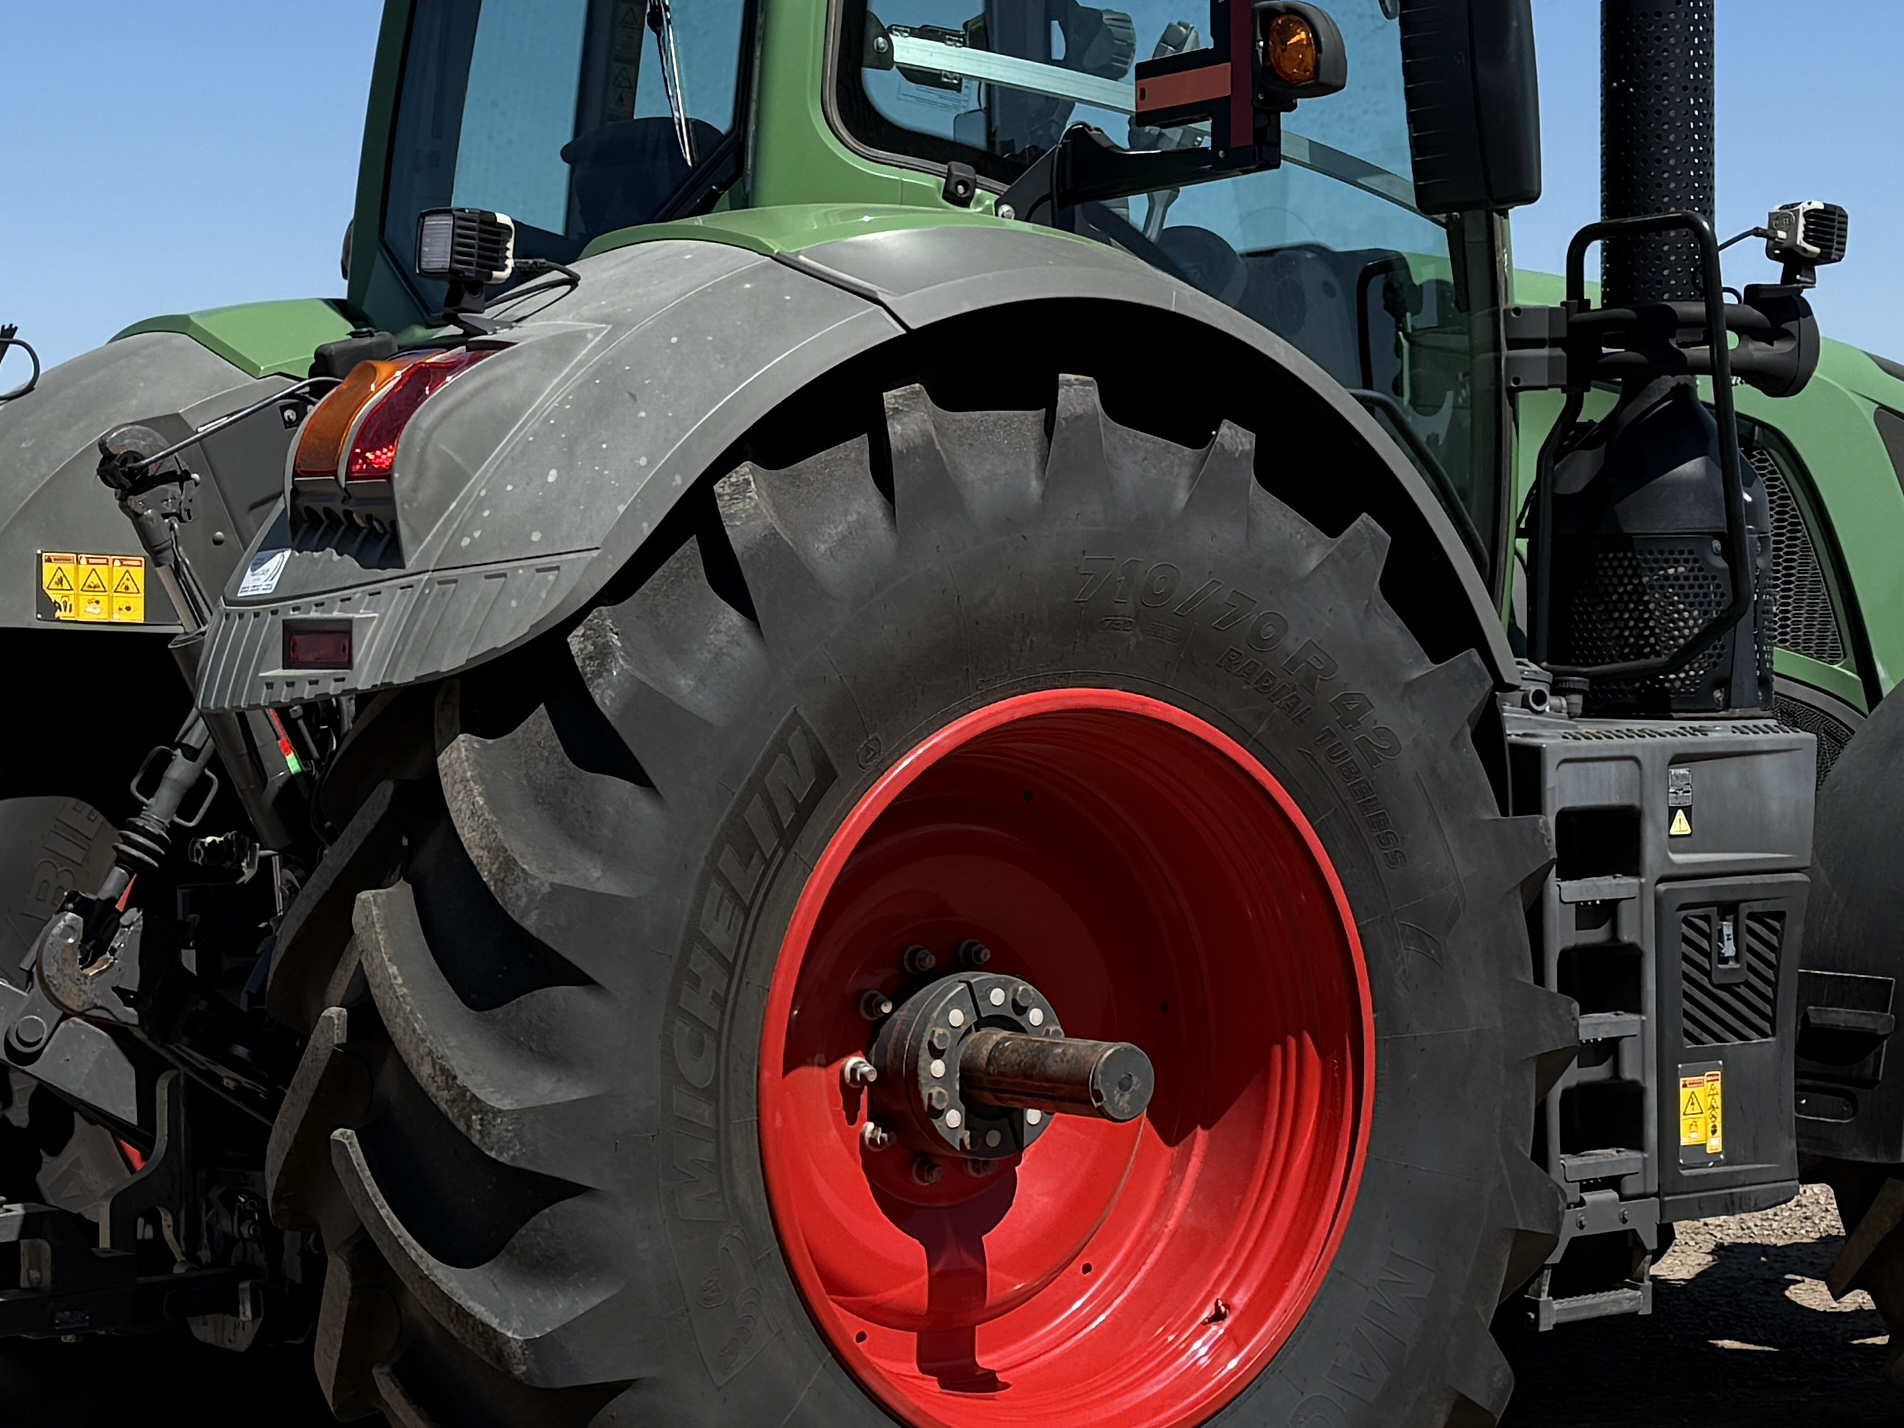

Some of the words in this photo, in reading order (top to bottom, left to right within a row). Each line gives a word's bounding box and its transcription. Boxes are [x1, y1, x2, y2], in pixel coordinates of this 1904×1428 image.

[1073, 555, 1289, 652] 710/70
[1216, 646, 1314, 728] RADIAL
[1314, 726, 1408, 869] TUBELESS
[672, 725, 818, 1221] MICHELIN
